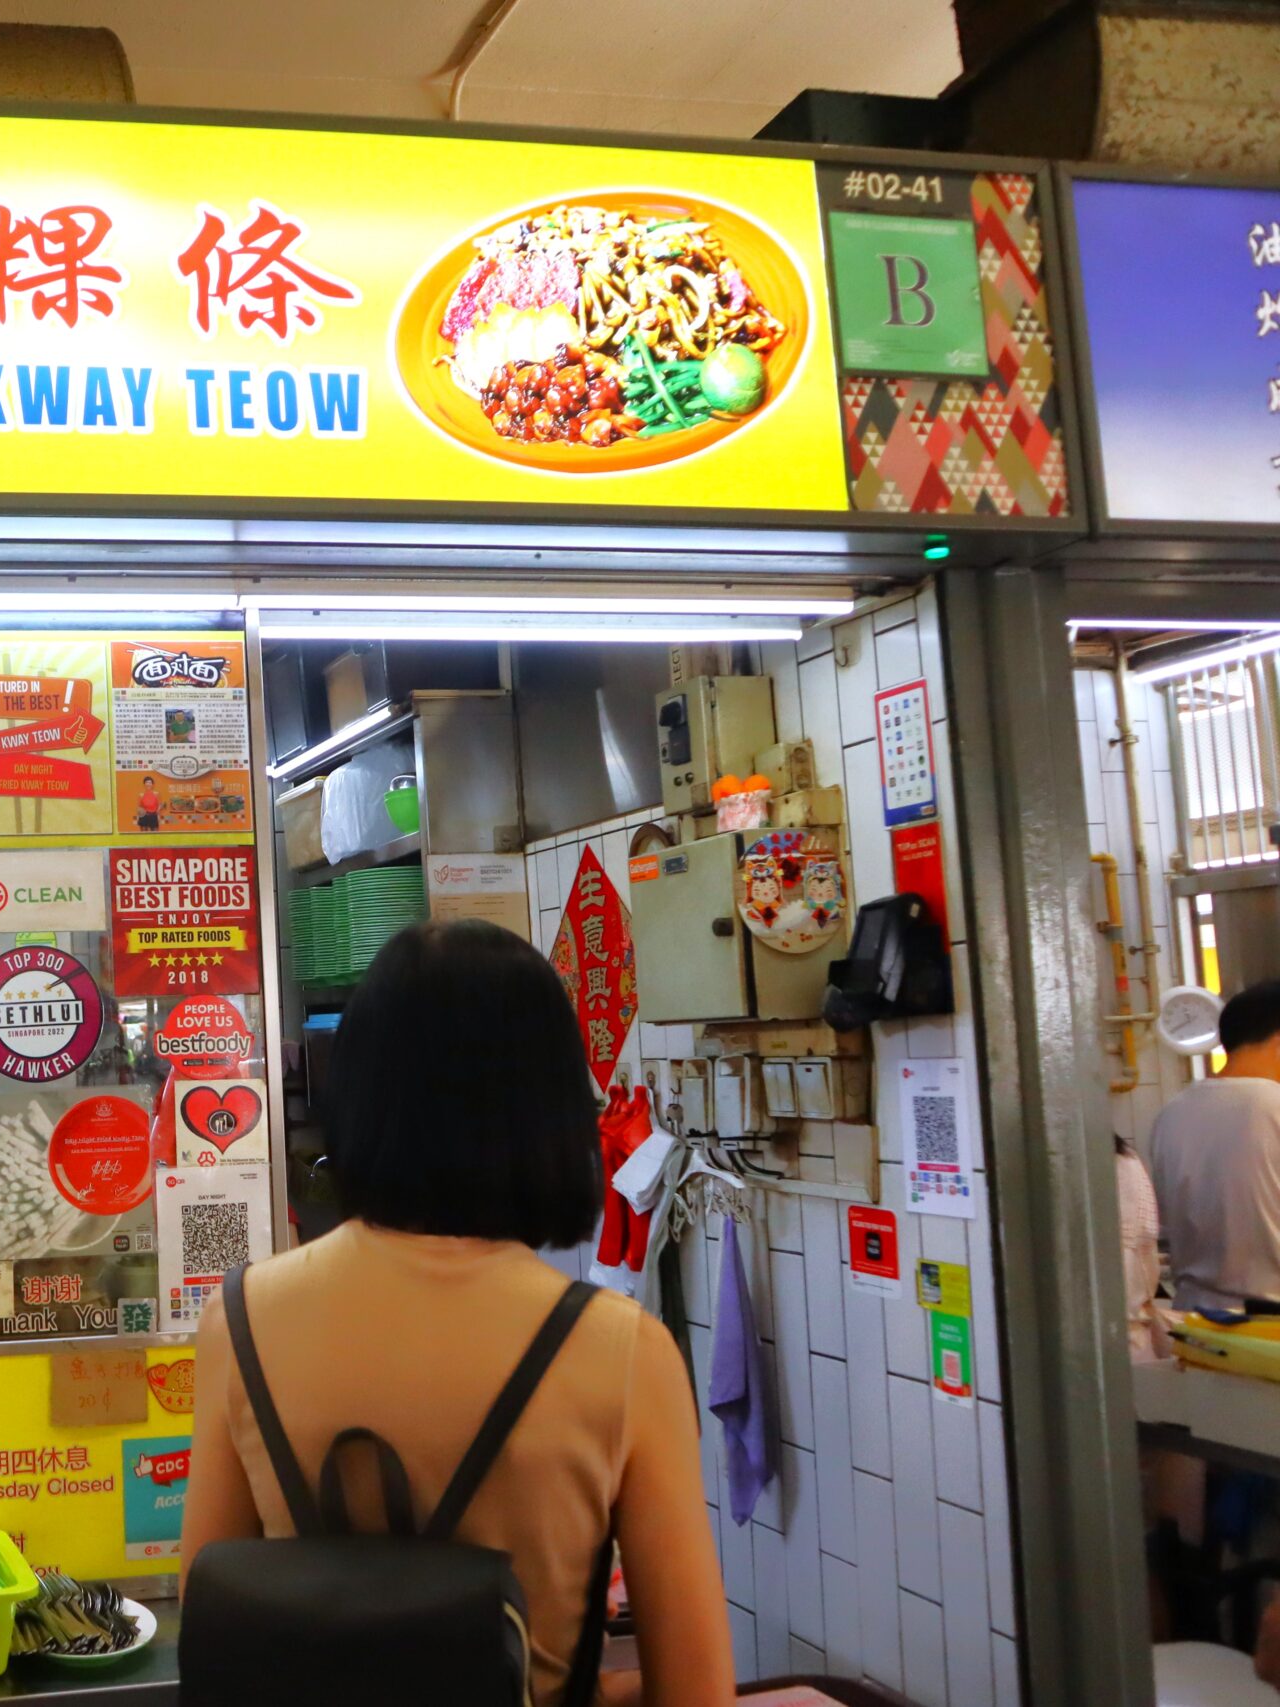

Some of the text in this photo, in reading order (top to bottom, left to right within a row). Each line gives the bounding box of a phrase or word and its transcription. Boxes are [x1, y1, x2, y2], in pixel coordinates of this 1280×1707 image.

[844, 171, 943, 203] #02-41
[876, 253, 935, 326] B
[186, 369, 359, 431] TEOW
[134, 653, 224, 683] 面对面
[31, 681, 40, 692] IN
[4, 695, 26, 711] THE
[30, 694, 60, 710] BEST
[1, 733, 30, 749] KWAY
[32, 728, 61, 743] TEOW
[14, 764, 53, 774] DAY NIGHT
[0, 779, 70, 790] FRIED KWAY TEOW
[116, 857, 249, 884] SINGAPORE
[14, 886, 83, 903] CLEAN
[120, 885, 246, 910] BEST FOODS
[157, 913, 212, 926] ENJOY
[138, 930, 231, 944] TOP RATED FOODS
[4, 952, 65, 972] TOP 300
[578, 866, 615, 1063] 生意興隆
[167, 971, 209, 985] 2018
[184, 1004, 225, 1014] PEOPLE
[176, 1016, 233, 1028] LOVE US
[8, 1028, 65, 1038] SINGAPORE 2022
[158, 1031, 251, 1057] bestfoody
[2, 1052, 75, 1079] HAWKER
[23, 1274, 81, 1304] 谢谢
[74, 1304, 119, 1331] You
[122, 1302, 152, 1334] 發
[155, 1458, 184, 1474] CDC
[48, 1476, 114, 1496] Closed
